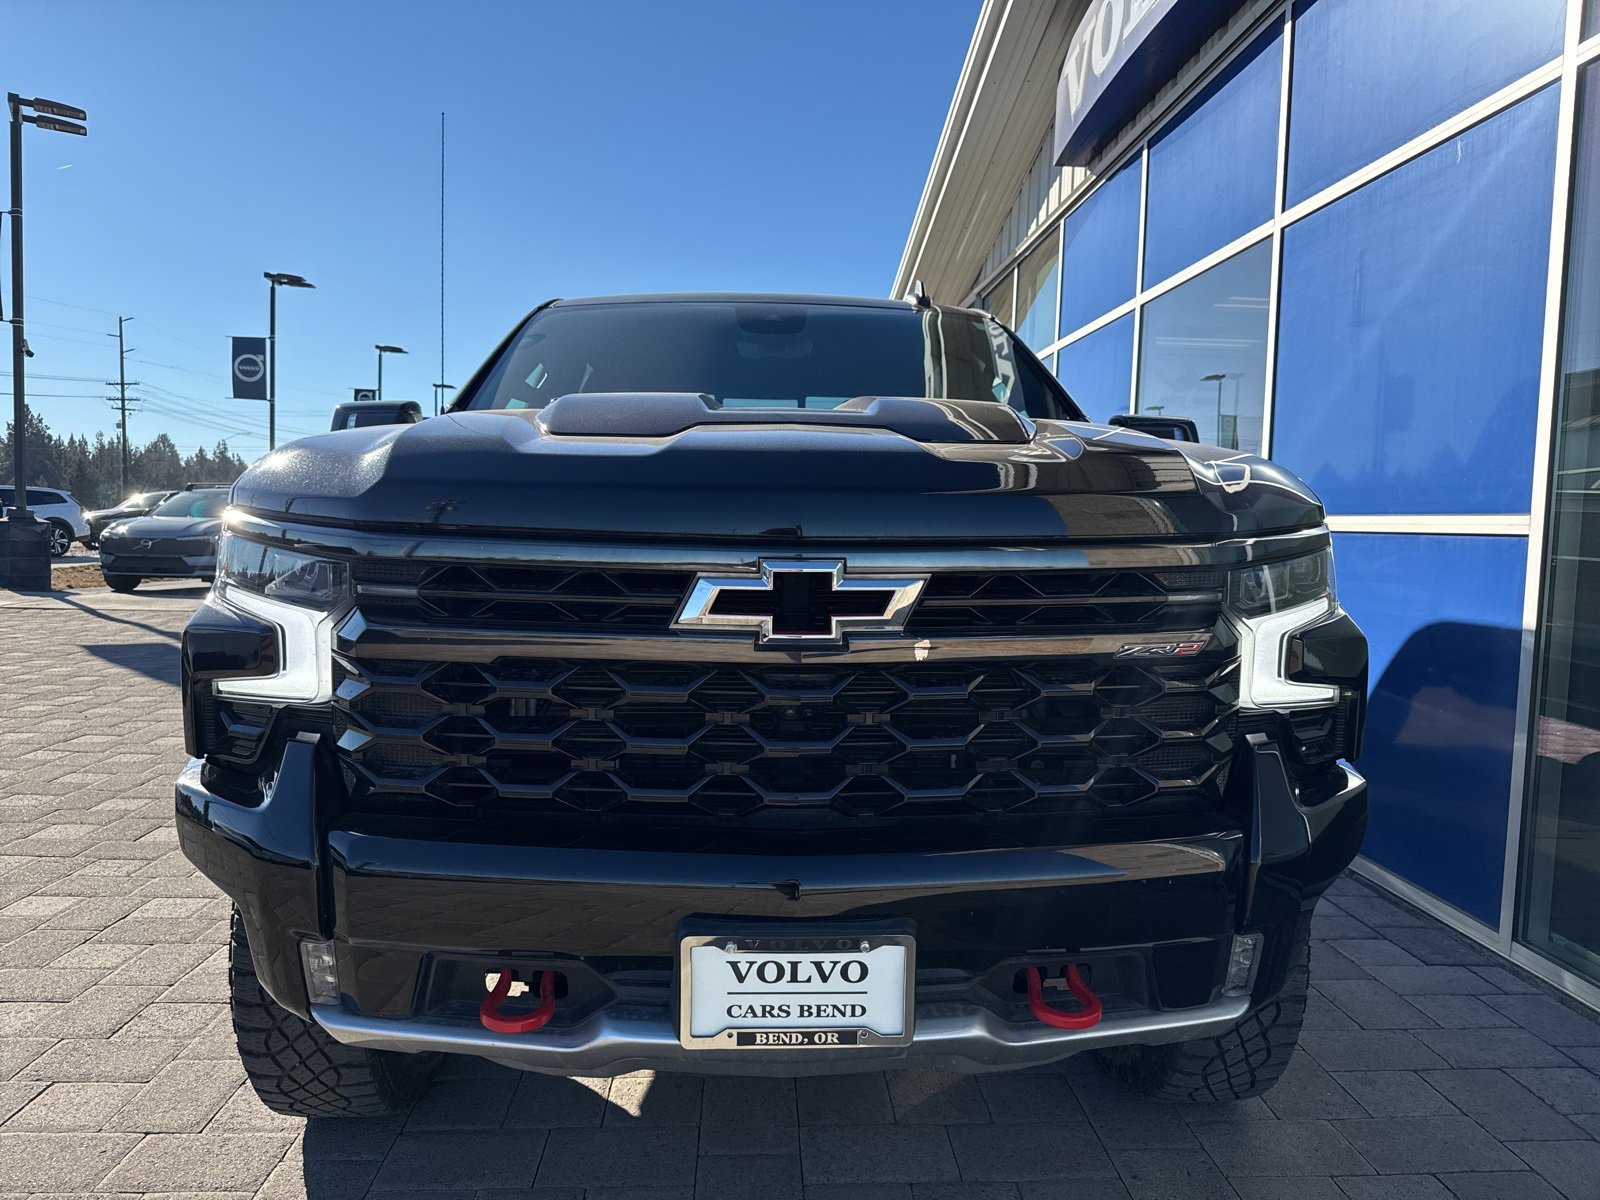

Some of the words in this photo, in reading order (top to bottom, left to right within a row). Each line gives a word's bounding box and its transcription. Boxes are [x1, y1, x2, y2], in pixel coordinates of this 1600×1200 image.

[1113, 642, 1205, 659] ZR2
[744, 939, 853, 950] VOLVO
[726, 960, 869, 984] VOLVO
[726, 1004, 791, 1019] CARS
[797, 1004, 867, 1018] BEND
[754, 1032, 809, 1045] BEND,
[813, 1032, 840, 1044] OR
